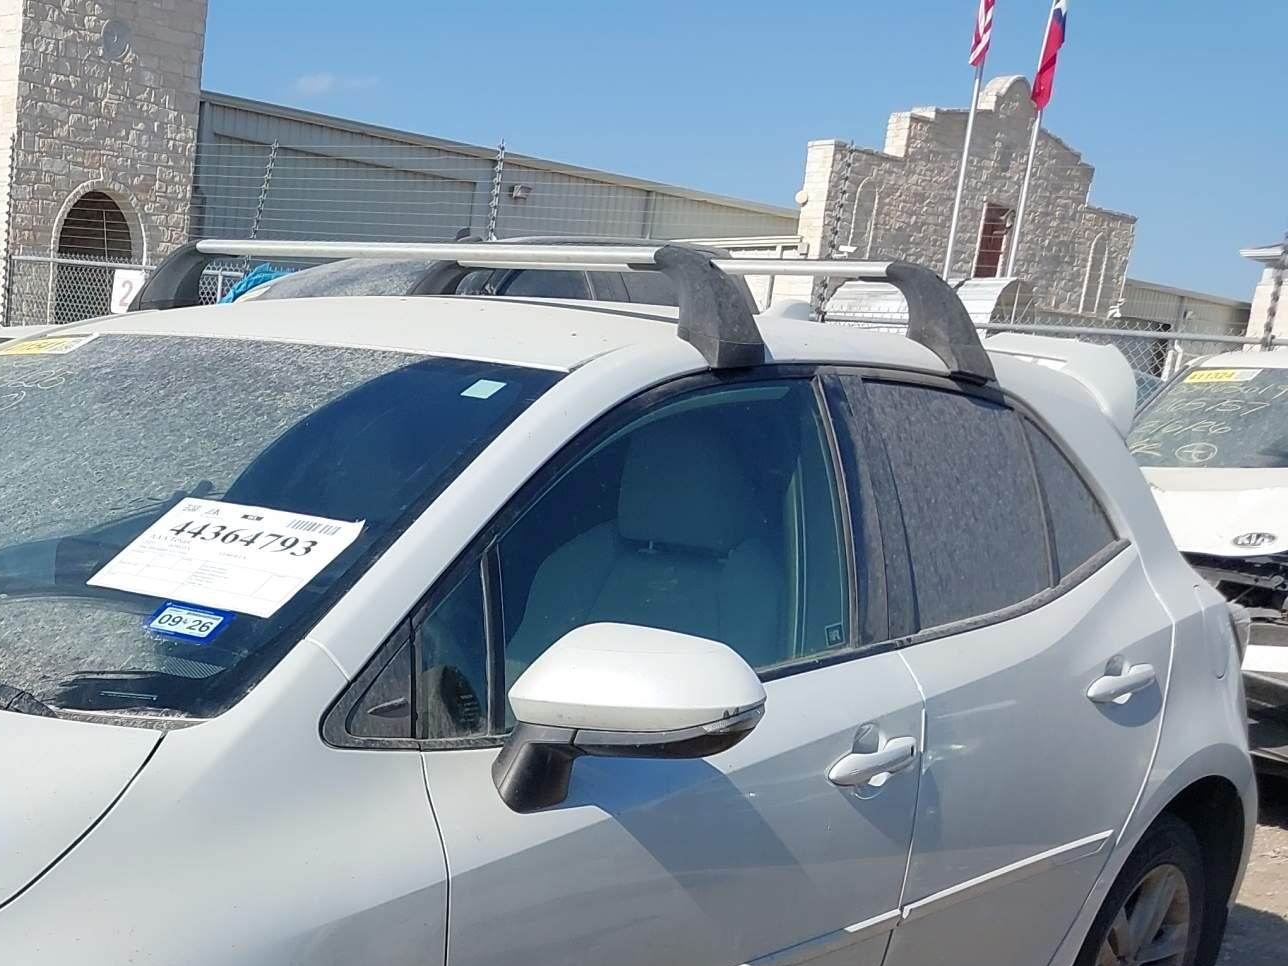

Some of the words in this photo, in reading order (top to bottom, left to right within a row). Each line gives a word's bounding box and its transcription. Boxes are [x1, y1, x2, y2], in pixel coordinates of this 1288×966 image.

[119, 279, 133, 307] 2
[170, 521, 318, 556] 44364793
[1236, 532, 1275, 546] KIA
[158, 613, 183, 627] 09
[186, 619, 214, 633] 26
